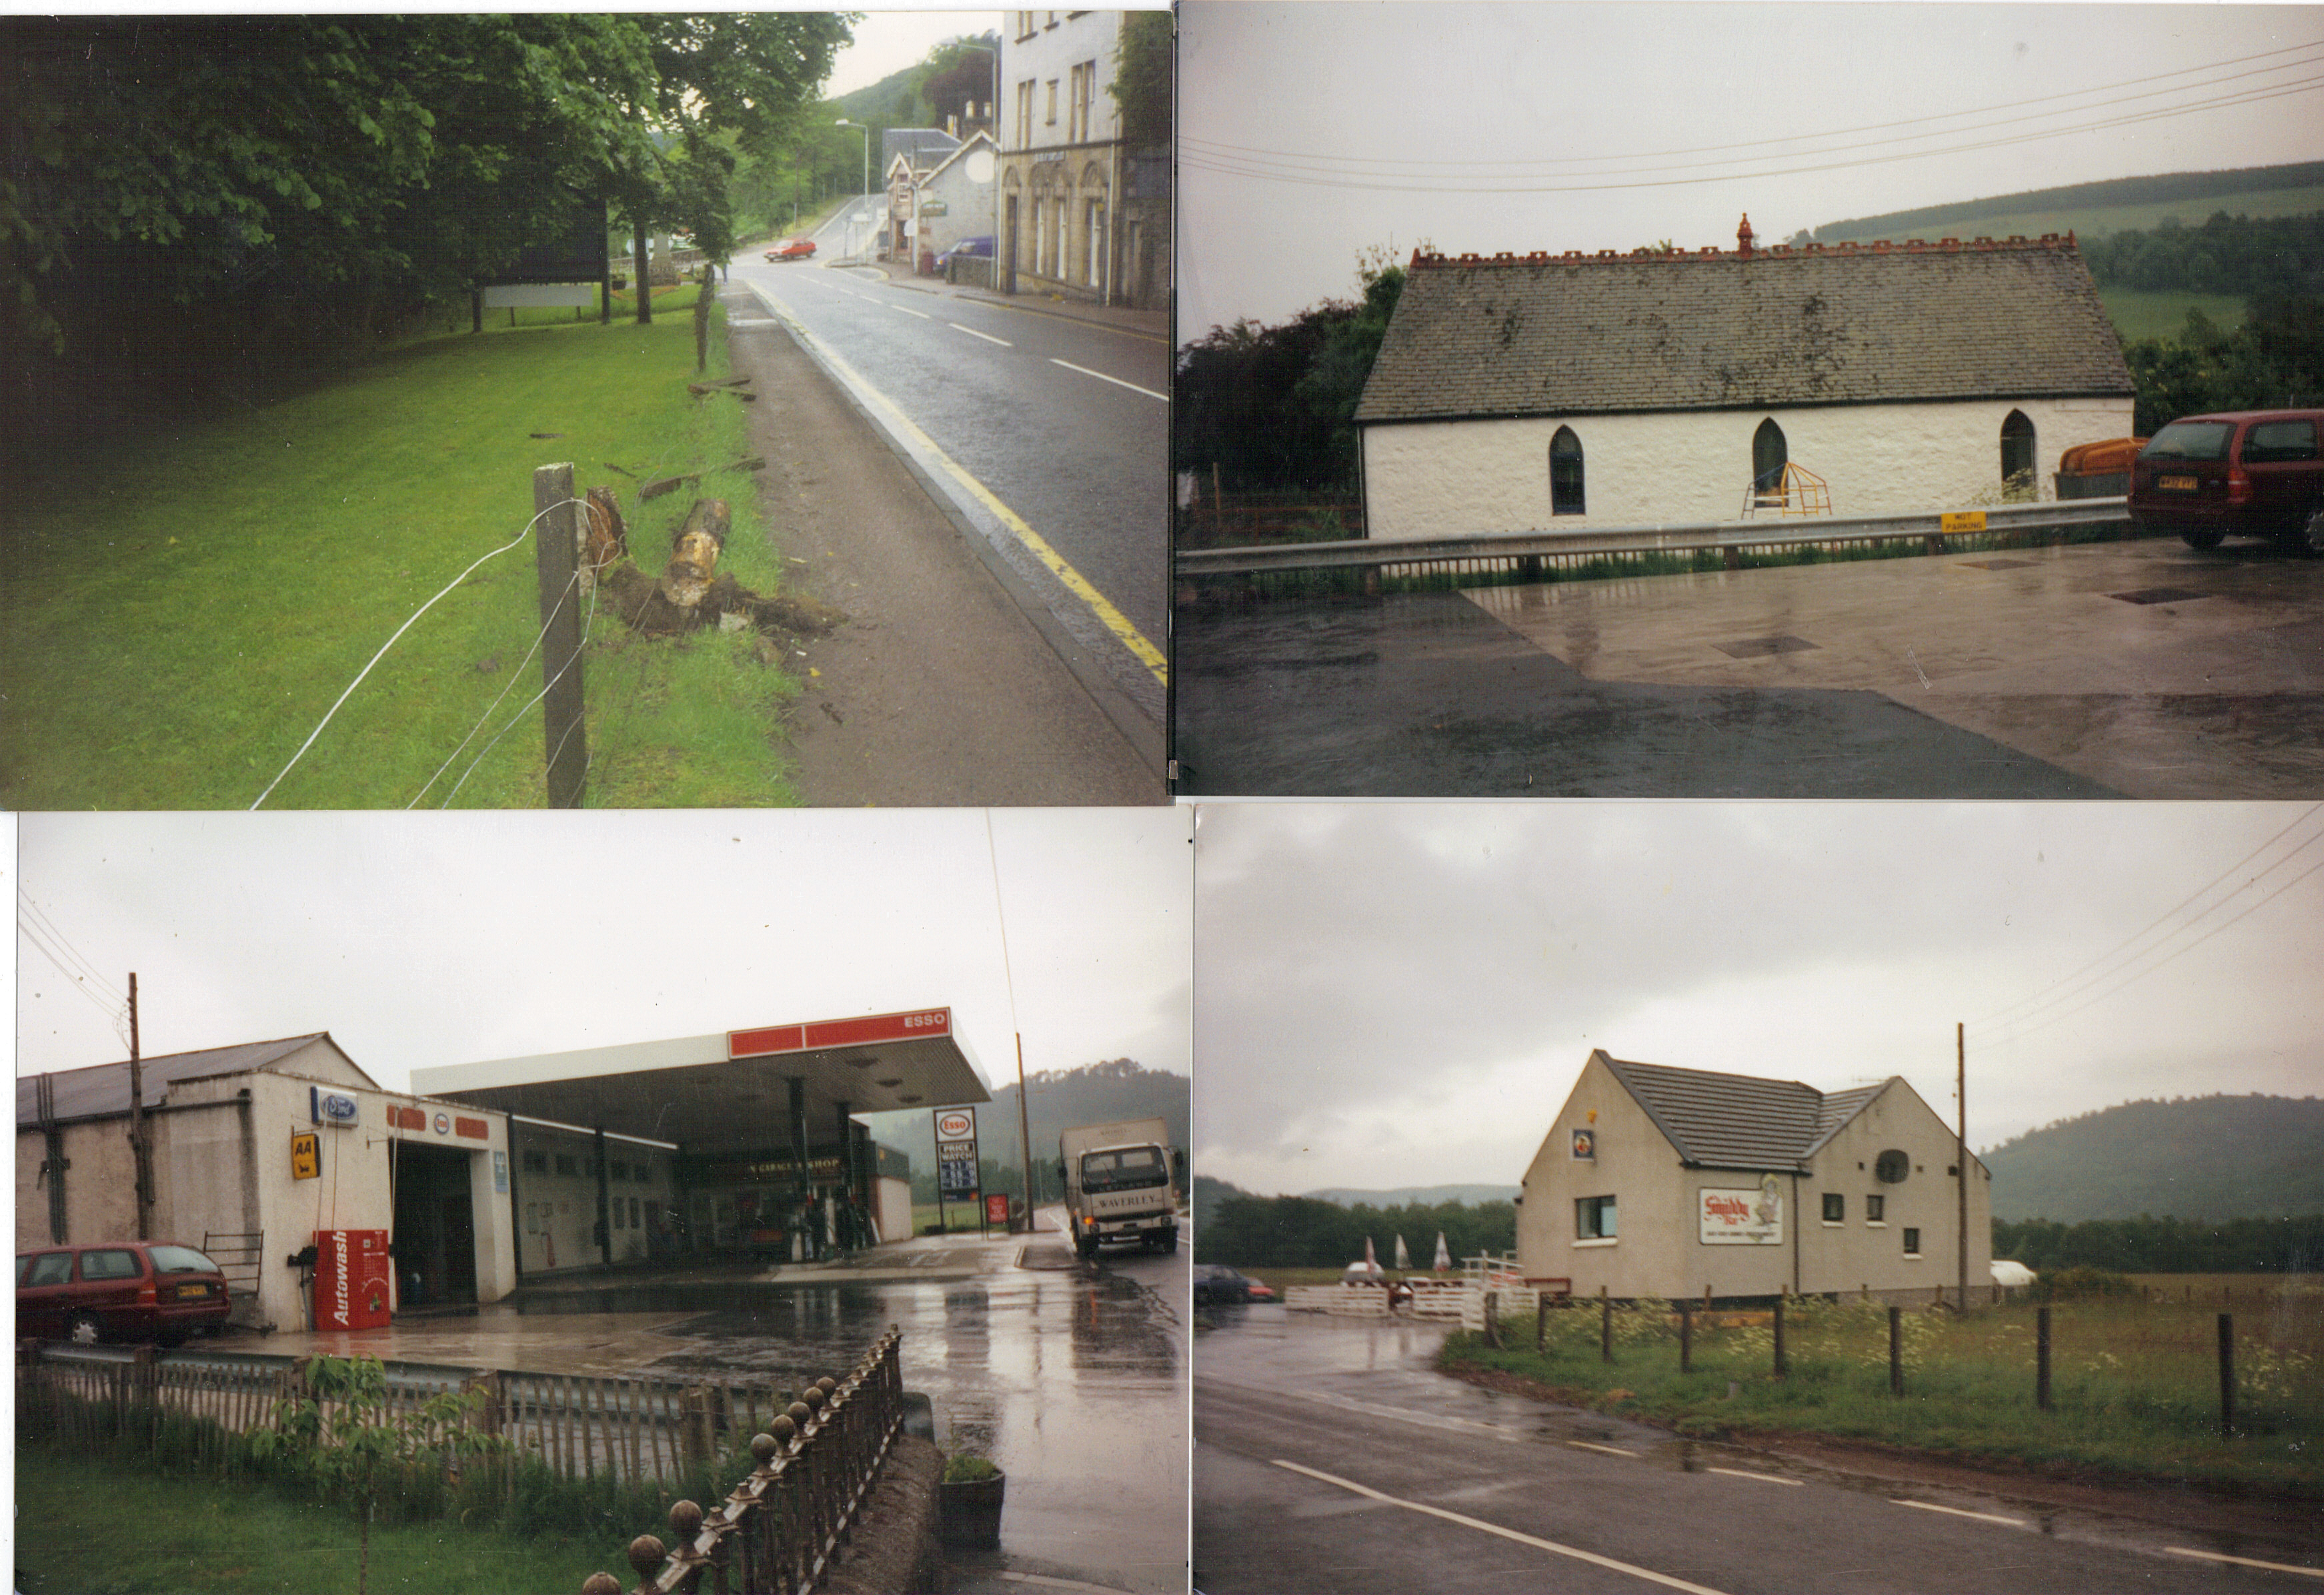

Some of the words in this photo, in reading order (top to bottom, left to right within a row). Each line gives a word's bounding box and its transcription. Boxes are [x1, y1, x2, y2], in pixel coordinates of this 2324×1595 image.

[1945, 521, 1983, 531] PARKING
[904, 1013, 945, 1028] ESSO
[329, 1100, 350, 1114] Ford
[436, 1118, 447, 1128] Esso
[944, 1120, 966, 1130] Esso
[295, 1140, 311, 1156] AA
[944, 1144, 969, 1152] PRICE
[942, 1153, 972, 1161] WATCH
[807, 1158, 839, 1170] SHOP
[1100, 1195, 1156, 1208] WAVERLEY
[332, 1231, 349, 1326] Autowash
